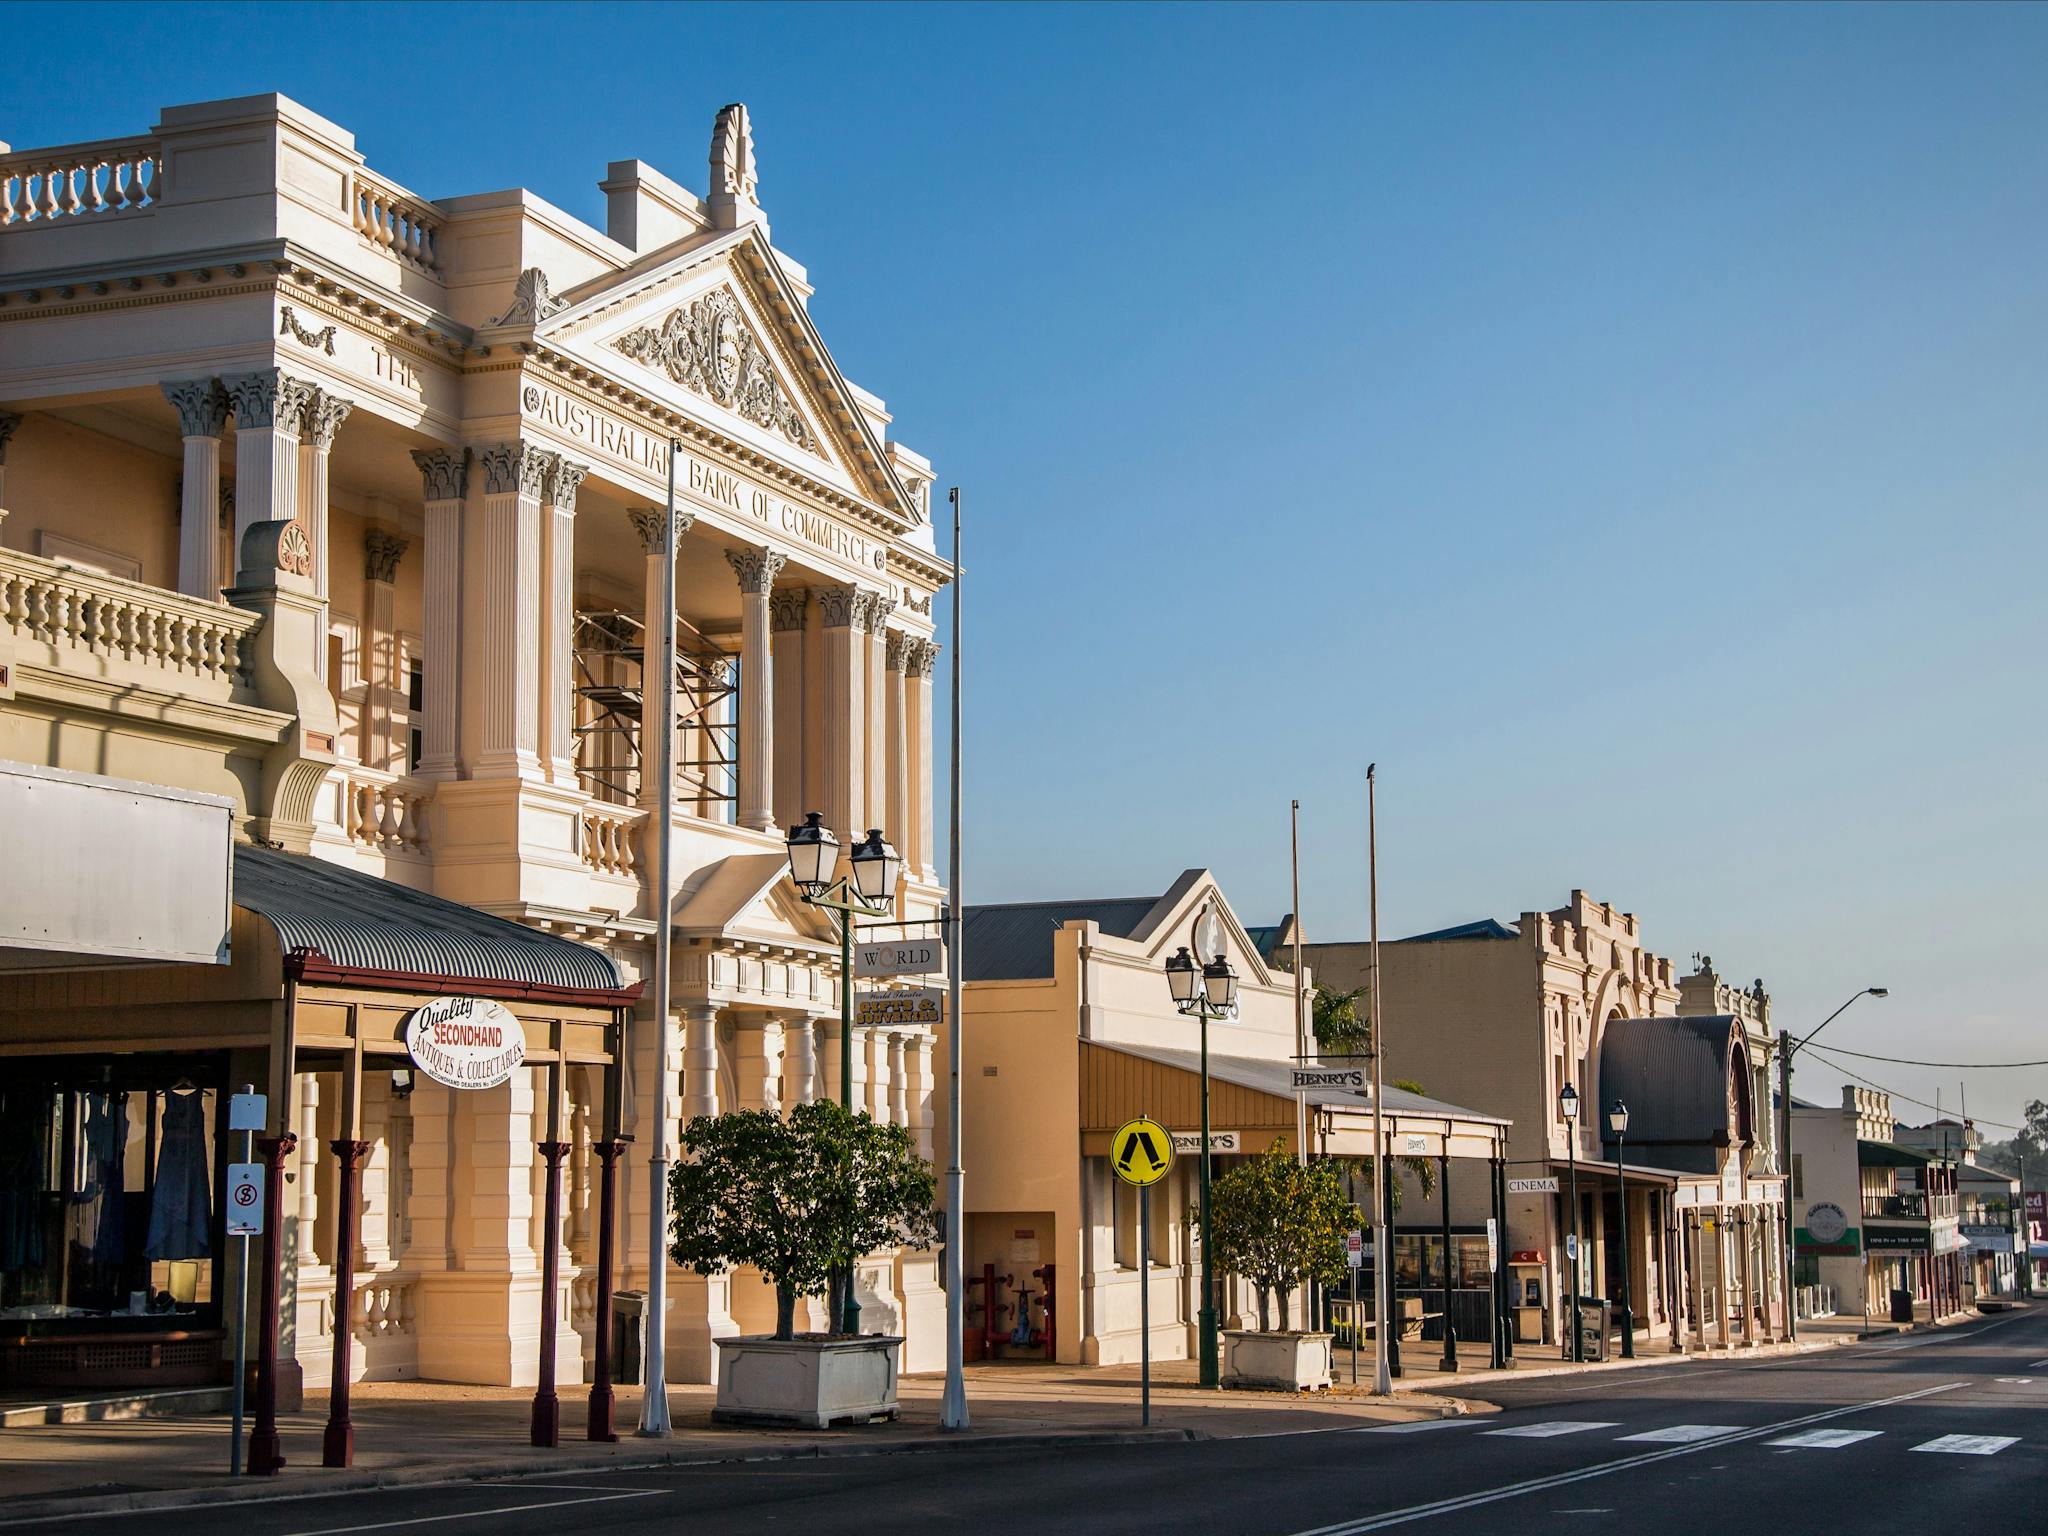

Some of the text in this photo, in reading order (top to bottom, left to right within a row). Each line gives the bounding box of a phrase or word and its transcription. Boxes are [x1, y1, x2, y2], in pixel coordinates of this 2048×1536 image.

[371, 344, 423, 392] THE
[540, 388, 873, 567] AUSTRALIAN BANK OF COMMERCE
[864, 946, 931, 968] WORLD
[420, 998, 474, 1034] Quality
[856, 1009, 939, 1024] SOUVENIRS
[859, 999, 936, 1013] GIFTS &
[434, 1023, 502, 1048] SECONDHAND
[413, 1034, 522, 1080] ANTIQUES & COLLECTABLES
[1293, 1071, 1362, 1087] HENRY'S
[1508, 1180, 1556, 1191] CINEMA
[2026, 1193, 2043, 1207] ed
